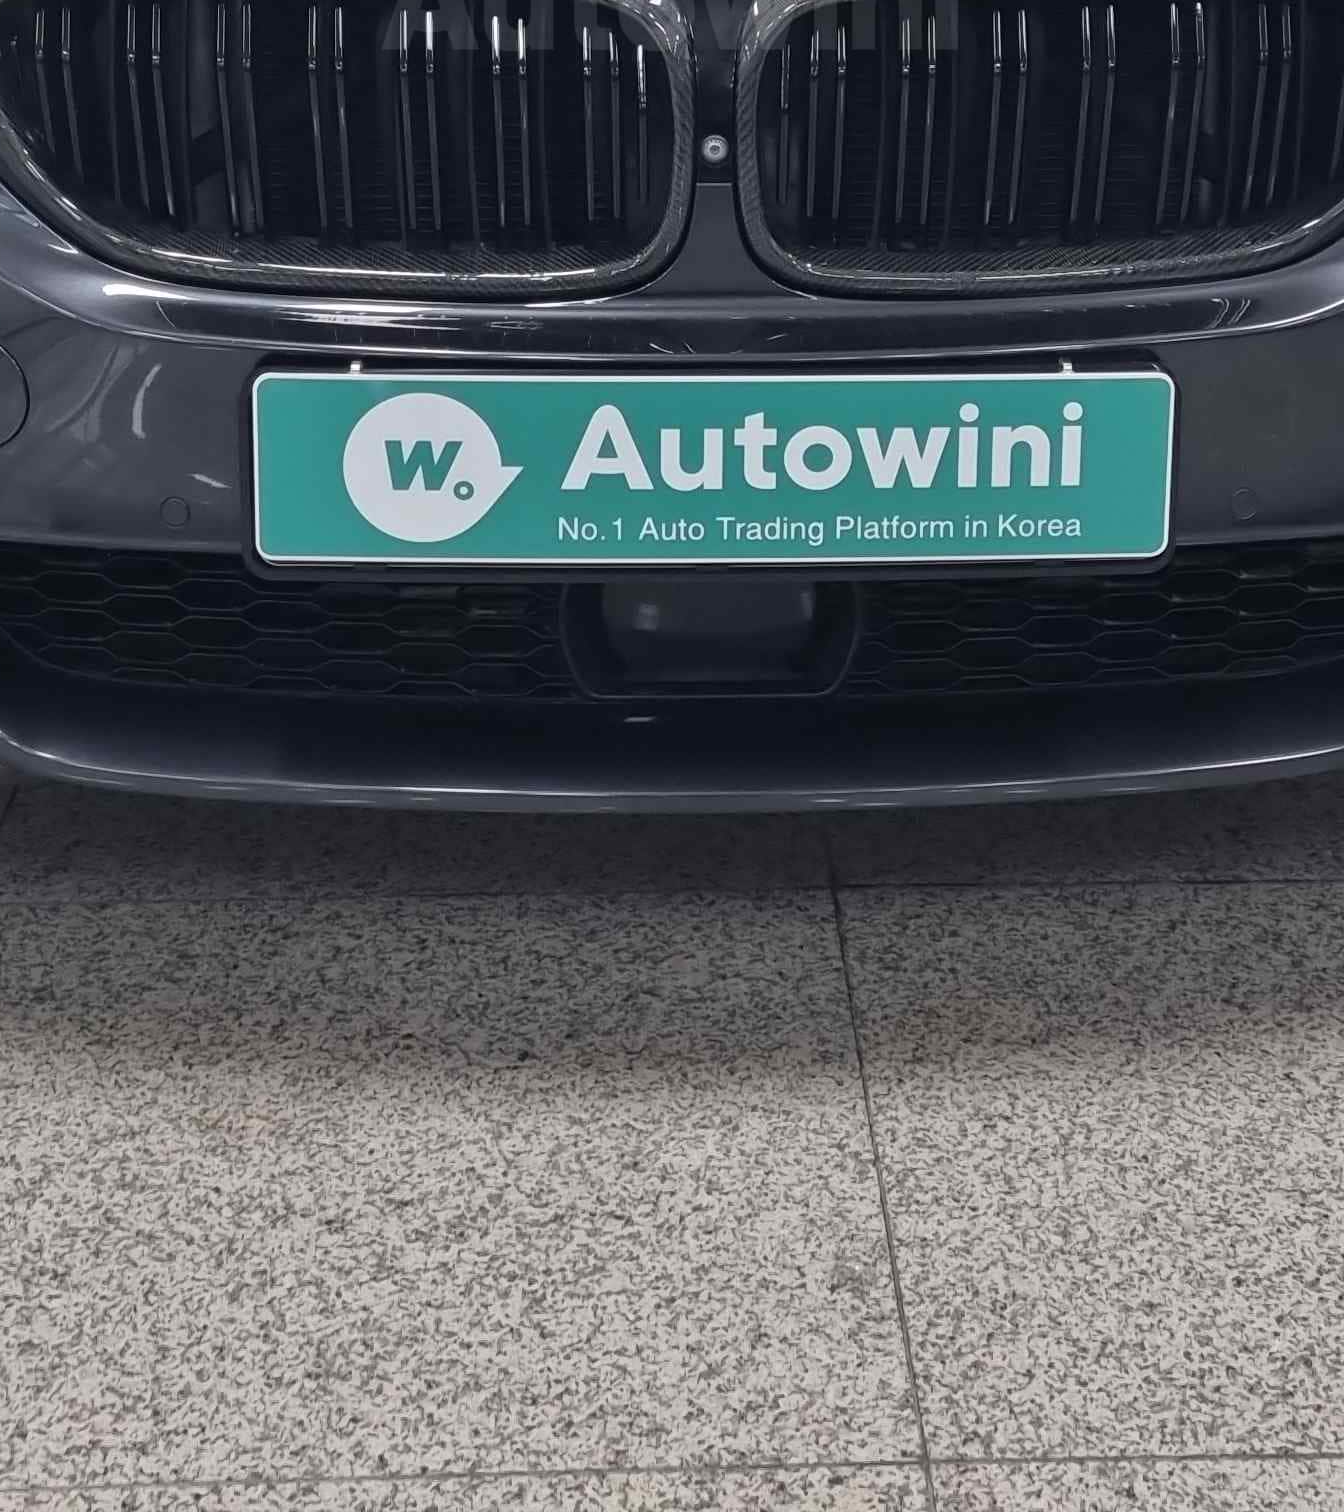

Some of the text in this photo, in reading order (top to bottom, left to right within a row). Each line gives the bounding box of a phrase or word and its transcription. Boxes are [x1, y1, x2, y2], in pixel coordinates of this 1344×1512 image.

[560, 401, 1084, 491] Autowini
[638, 516, 705, 541] Auto
[716, 516, 824, 546] Trading
[835, 514, 954, 539] Platform
[964, 514, 987, 537] in
[997, 513, 1082, 537] Korea
